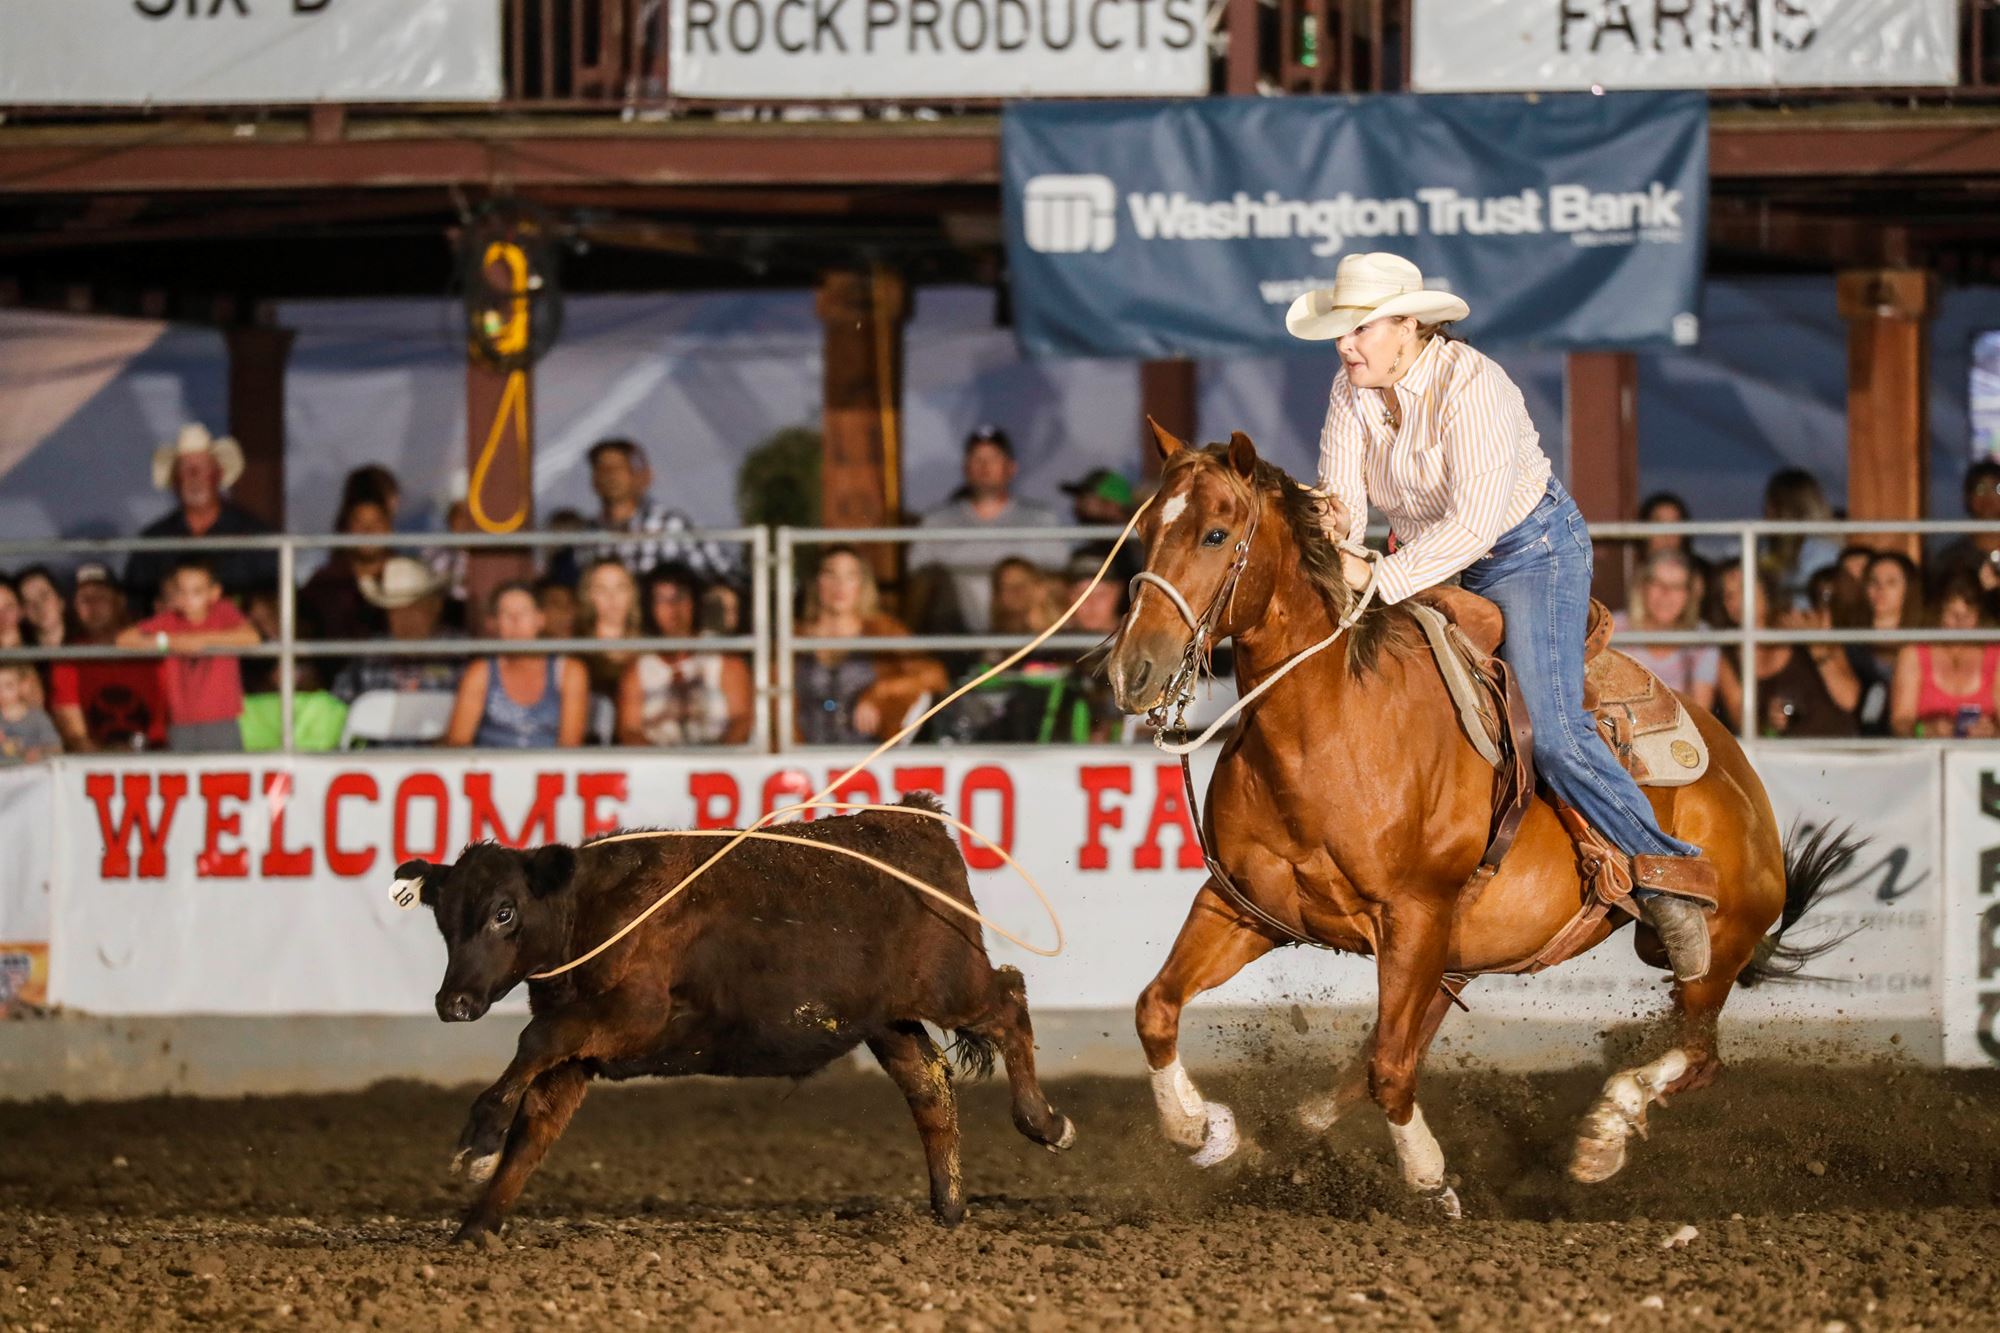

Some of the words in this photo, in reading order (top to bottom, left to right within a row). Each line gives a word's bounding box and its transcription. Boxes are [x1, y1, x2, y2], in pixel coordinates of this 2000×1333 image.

[684, 0, 849, 54] ROCK
[865, 0, 1196, 53] PRODUCTS
[1558, 0, 1816, 52] FARMS
[1128, 191, 1418, 257] Washington
[1417, 187, 1544, 235] Trust
[1549, 182, 1683, 232] Bank
[86, 771, 627, 878] WELCOME
[689, 765, 1015, 871] ROO
[393, 887, 414, 907] 18
